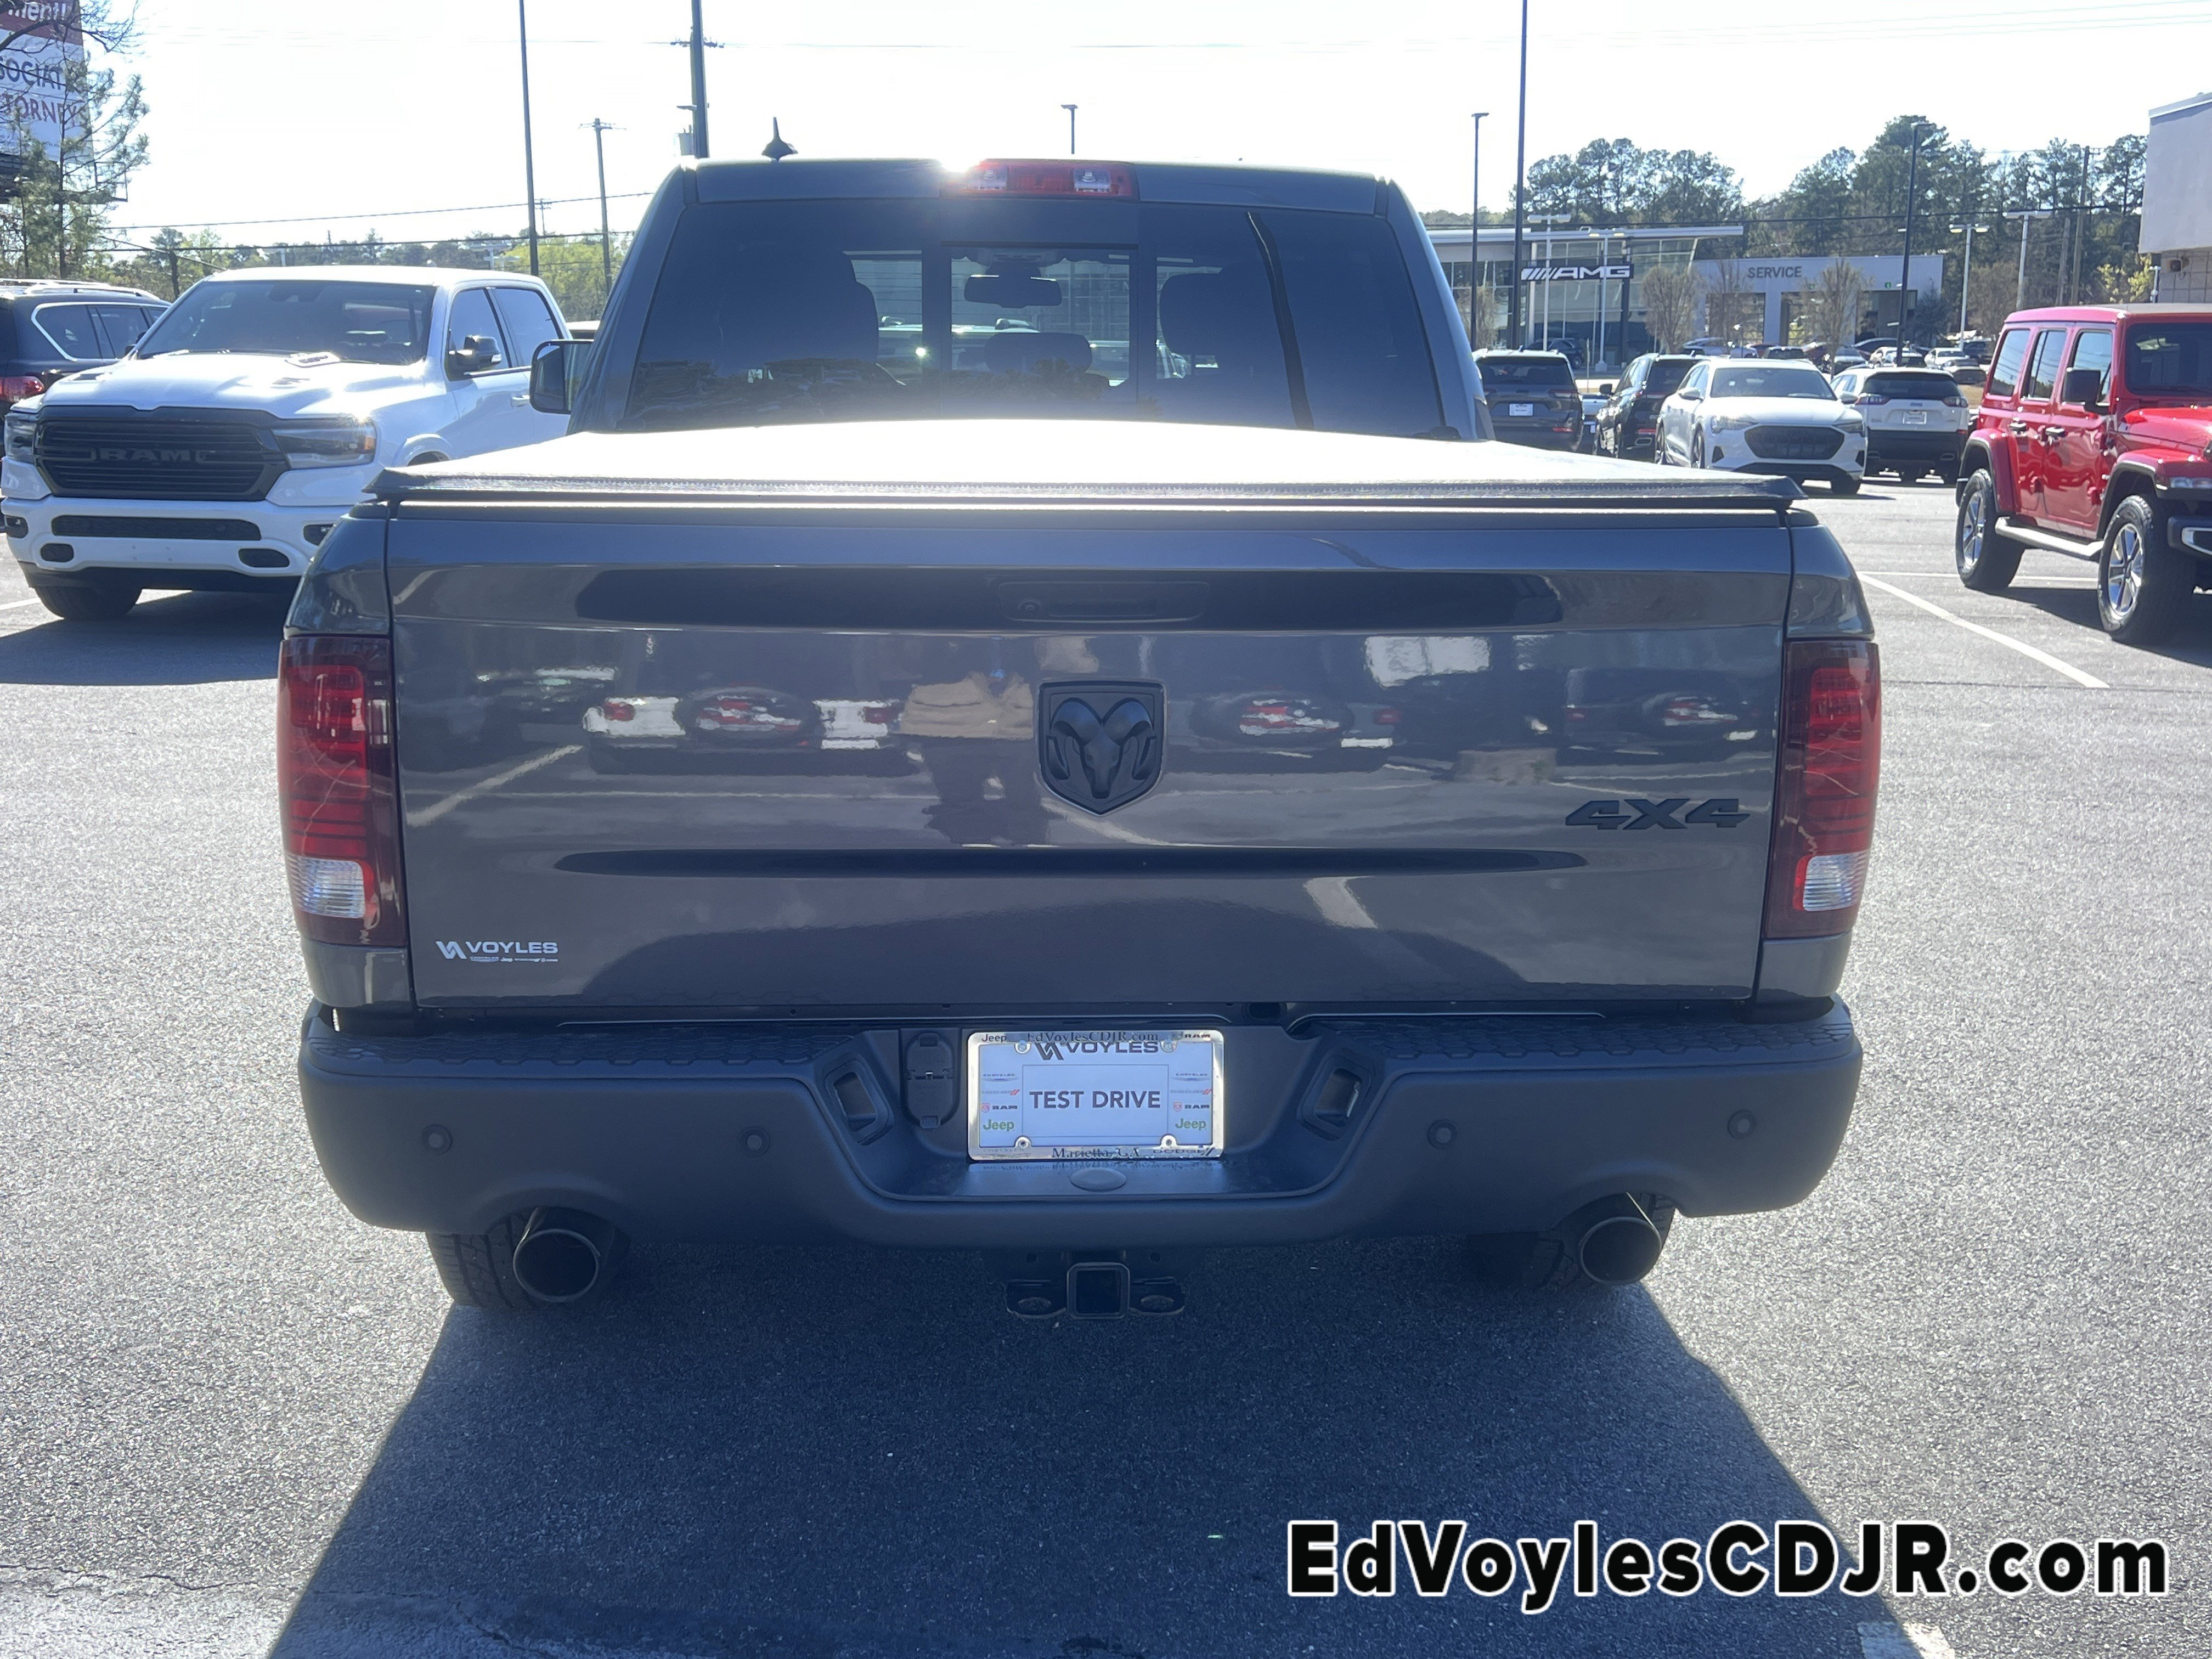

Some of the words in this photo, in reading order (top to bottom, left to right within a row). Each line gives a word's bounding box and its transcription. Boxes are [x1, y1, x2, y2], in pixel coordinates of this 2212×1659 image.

[1747, 266, 1802, 278] SERVICE
[100, 448, 191, 461] RAM
[466, 941, 558, 953] VOYLES
[981, 1034, 1007, 1042] Jeep
[1028, 1031, 1159, 1042] EdVoylesCDJR.com
[1066, 1041, 1159, 1053] VOYLES
[1029, 1091, 1085, 1109] TEST
[1092, 1090, 1160, 1108] DRIVE
[983, 1119, 1015, 1131] Jeep
[1175, 1118, 1207, 1131] Jeep
